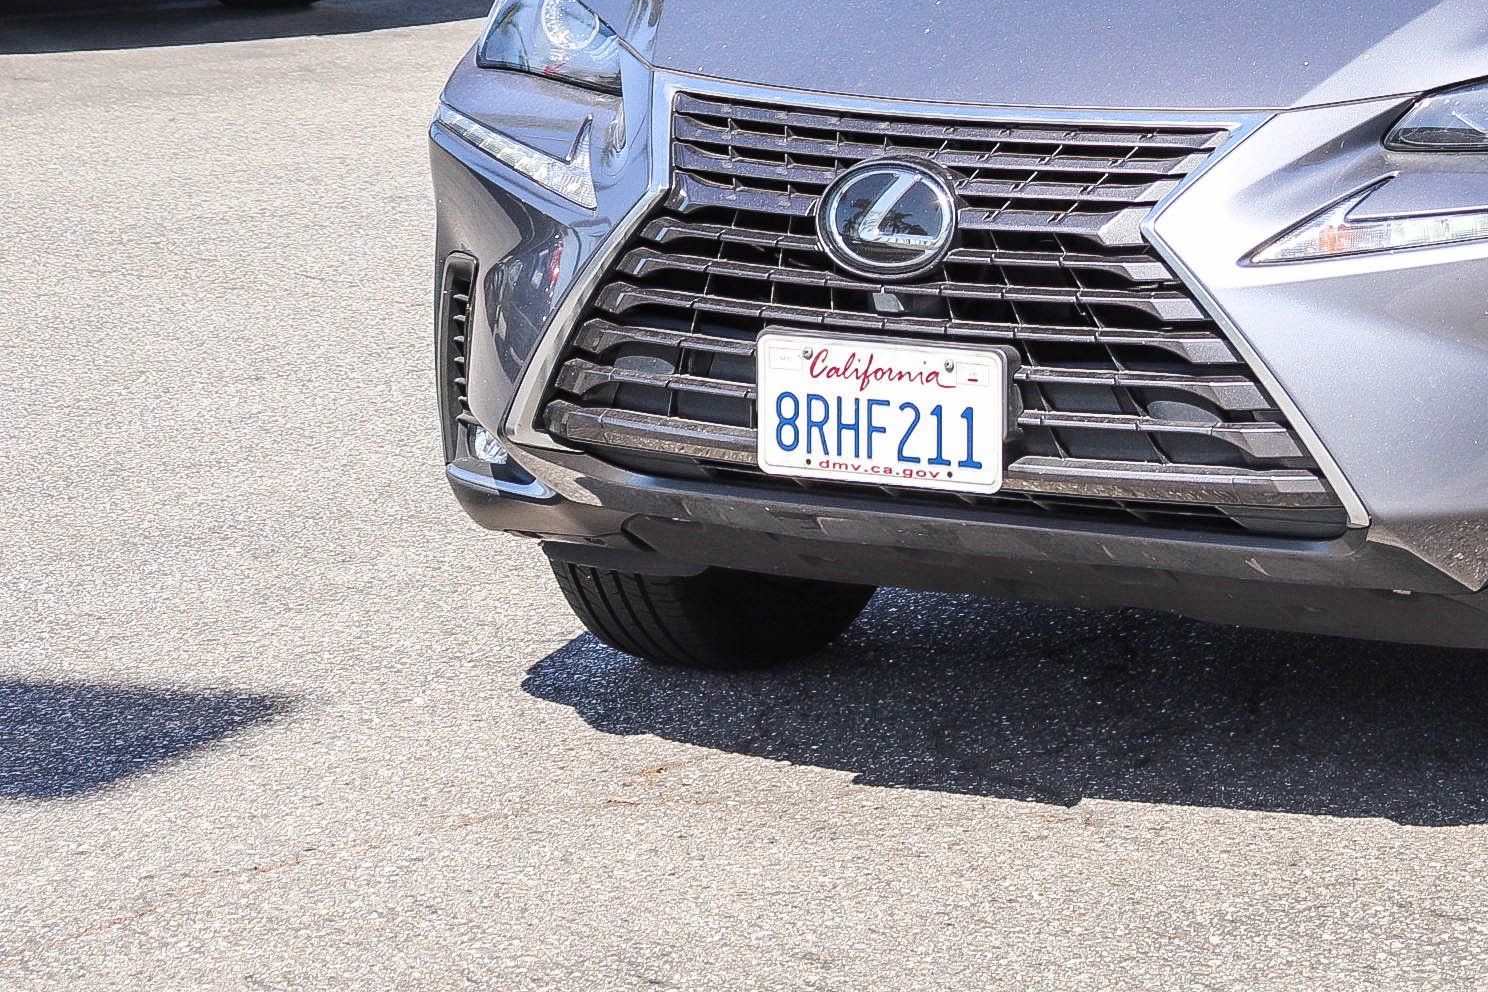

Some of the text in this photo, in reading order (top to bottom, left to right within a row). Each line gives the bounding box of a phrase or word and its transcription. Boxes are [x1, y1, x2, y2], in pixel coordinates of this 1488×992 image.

[809, 348, 957, 392] California
[775, 391, 983, 470] 8RHF211
[818, 459, 941, 479] dmv.ca.gov
